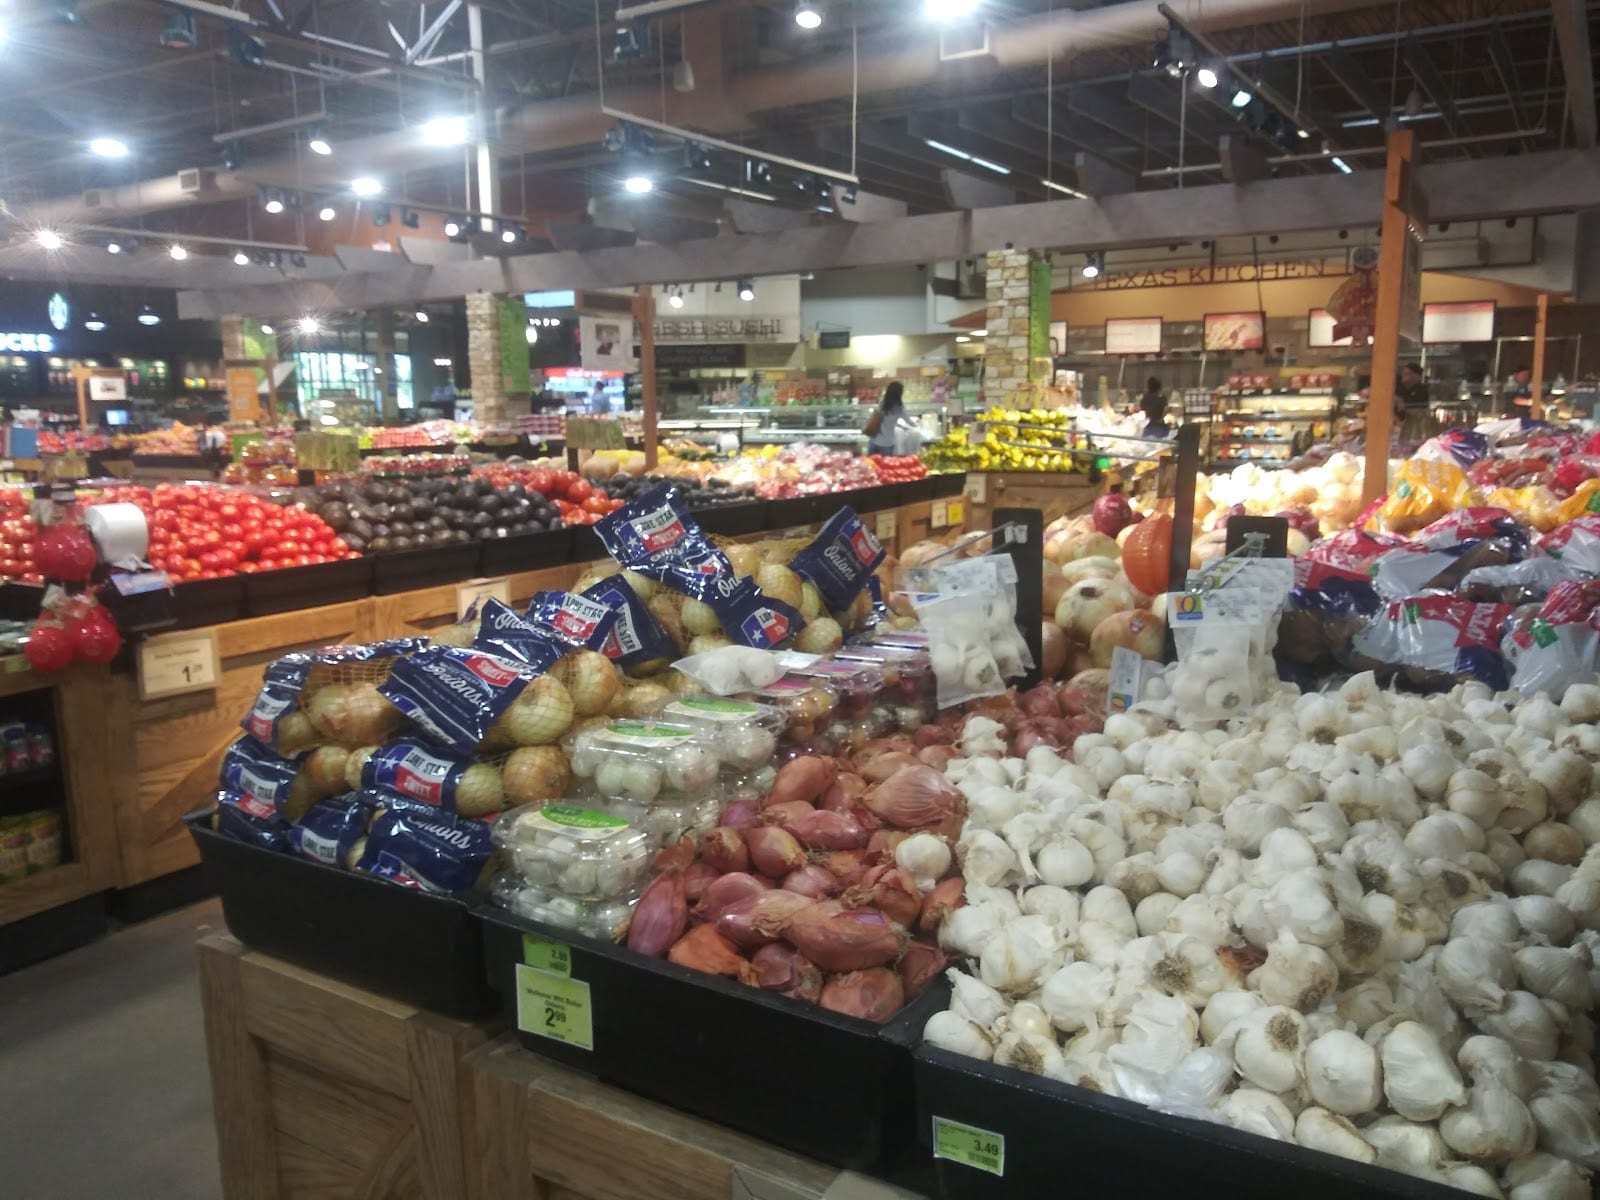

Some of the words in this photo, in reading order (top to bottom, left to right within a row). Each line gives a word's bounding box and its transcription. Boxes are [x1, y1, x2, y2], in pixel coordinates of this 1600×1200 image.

[1189, 259, 1326, 282] KITCHEN
[715, 318, 783, 336] SUSHI
[823, 545, 857, 581] Onions
[973, 1139, 999, 1156] 3.49
